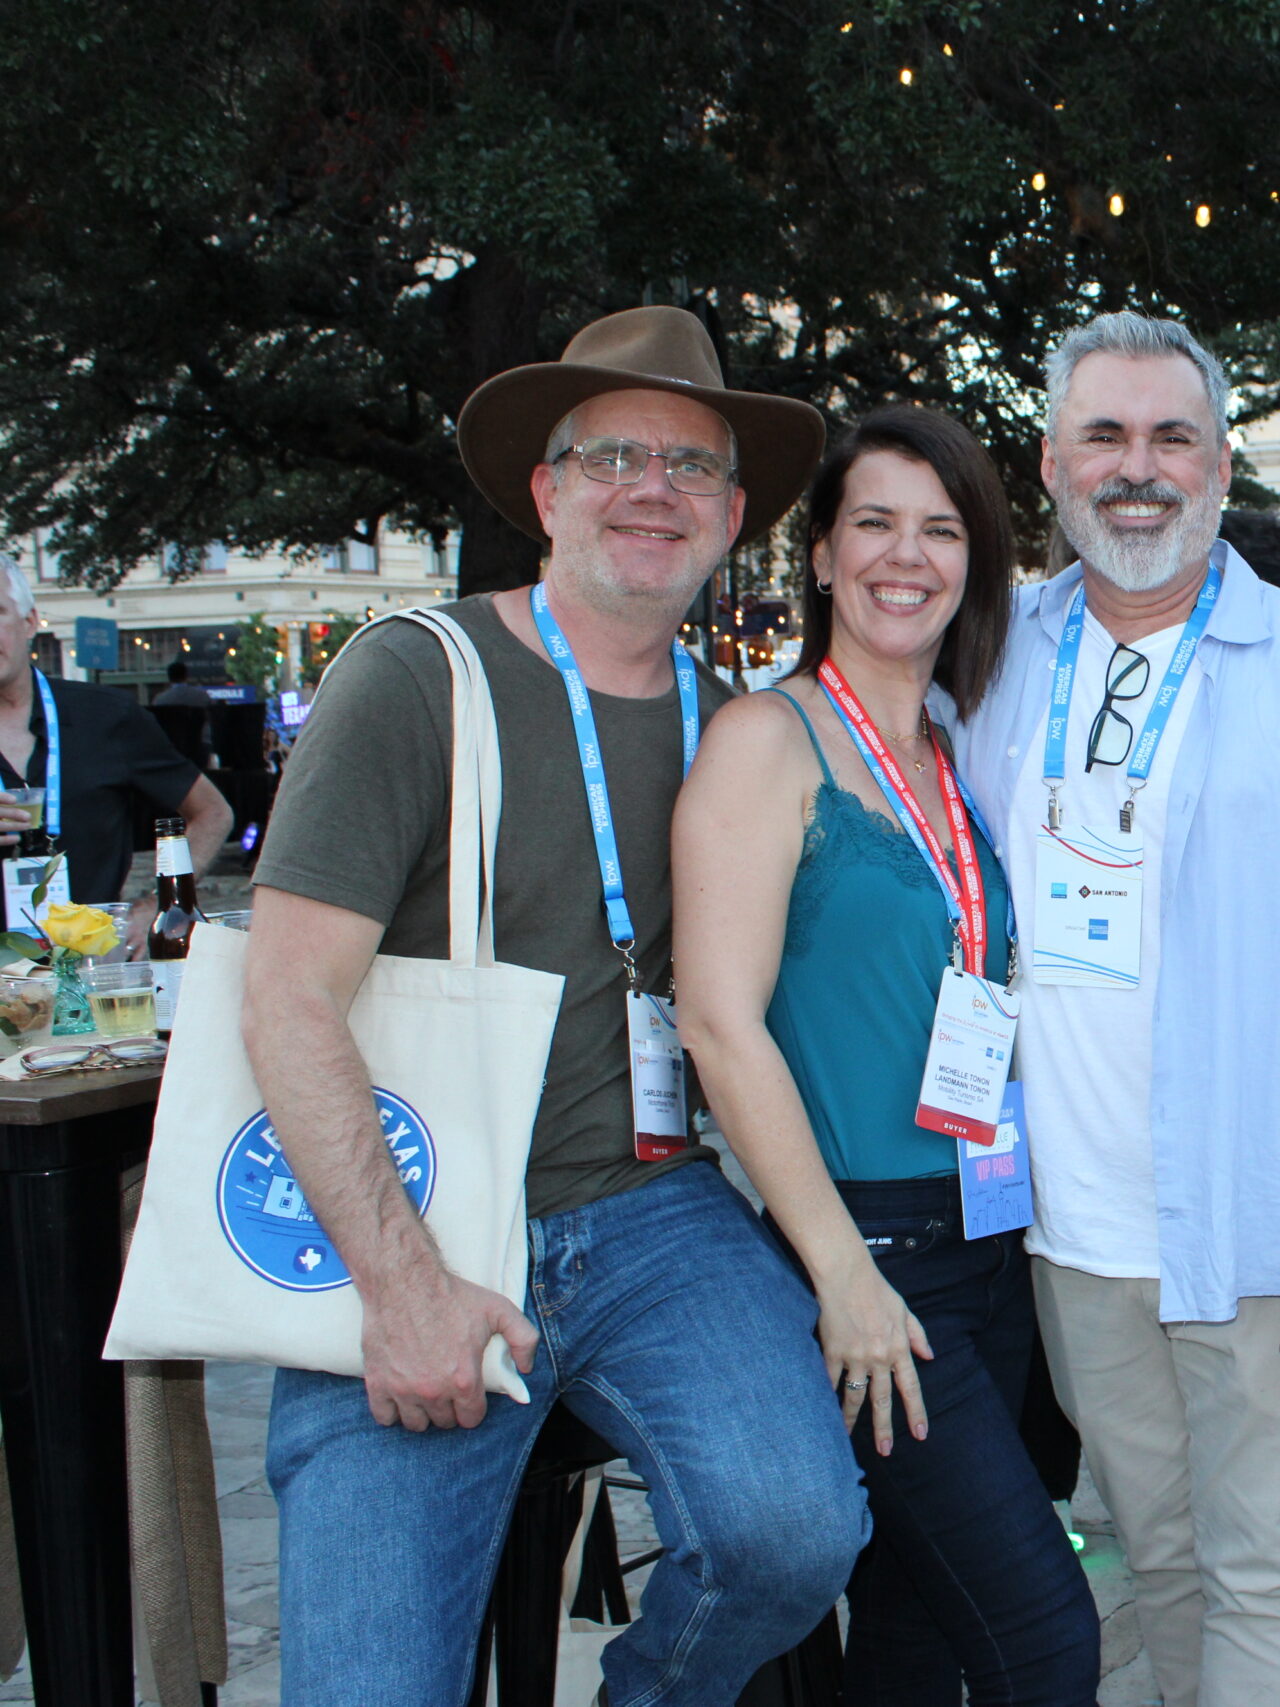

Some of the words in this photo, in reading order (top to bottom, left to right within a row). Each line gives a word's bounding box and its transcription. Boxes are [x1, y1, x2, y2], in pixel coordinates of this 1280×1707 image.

[1201, 584, 1217, 600] ipw
[1065, 624, 1080, 644] ipw
[1170, 639, 1190, 674] EXPRESS
[1177, 637, 1197, 675] AMERICAN
[564, 669, 583, 717] AMERICAN
[677, 668, 692, 692] ipw
[1054, 667, 1066, 705] EXPRESS
[1061, 663, 1073, 705] AMERICAN
[1158, 685, 1178, 708] ipw
[1051, 717, 1067, 741] ipw
[583, 743, 601, 769] ipw
[1131, 731, 1150, 770] EXPRESS
[1138, 728, 1159, 771] AMERICAN
[590, 784, 603, 833] AMERICAN
[595, 784, 608, 827] EXPRESS
[603, 860, 620, 886] ipw
[972, 994, 989, 1010] ipw
[935, 1074, 969, 1089] LANDMANN
[970, 1084, 991, 1096] TONON
[938, 1064, 969, 1080] MICHELLE
[969, 1074, 991, 1086] TONON
[943, 1122, 969, 1135] BUYER
[976, 1159, 991, 1182] VIP
[992, 1154, 1016, 1178] PASS
